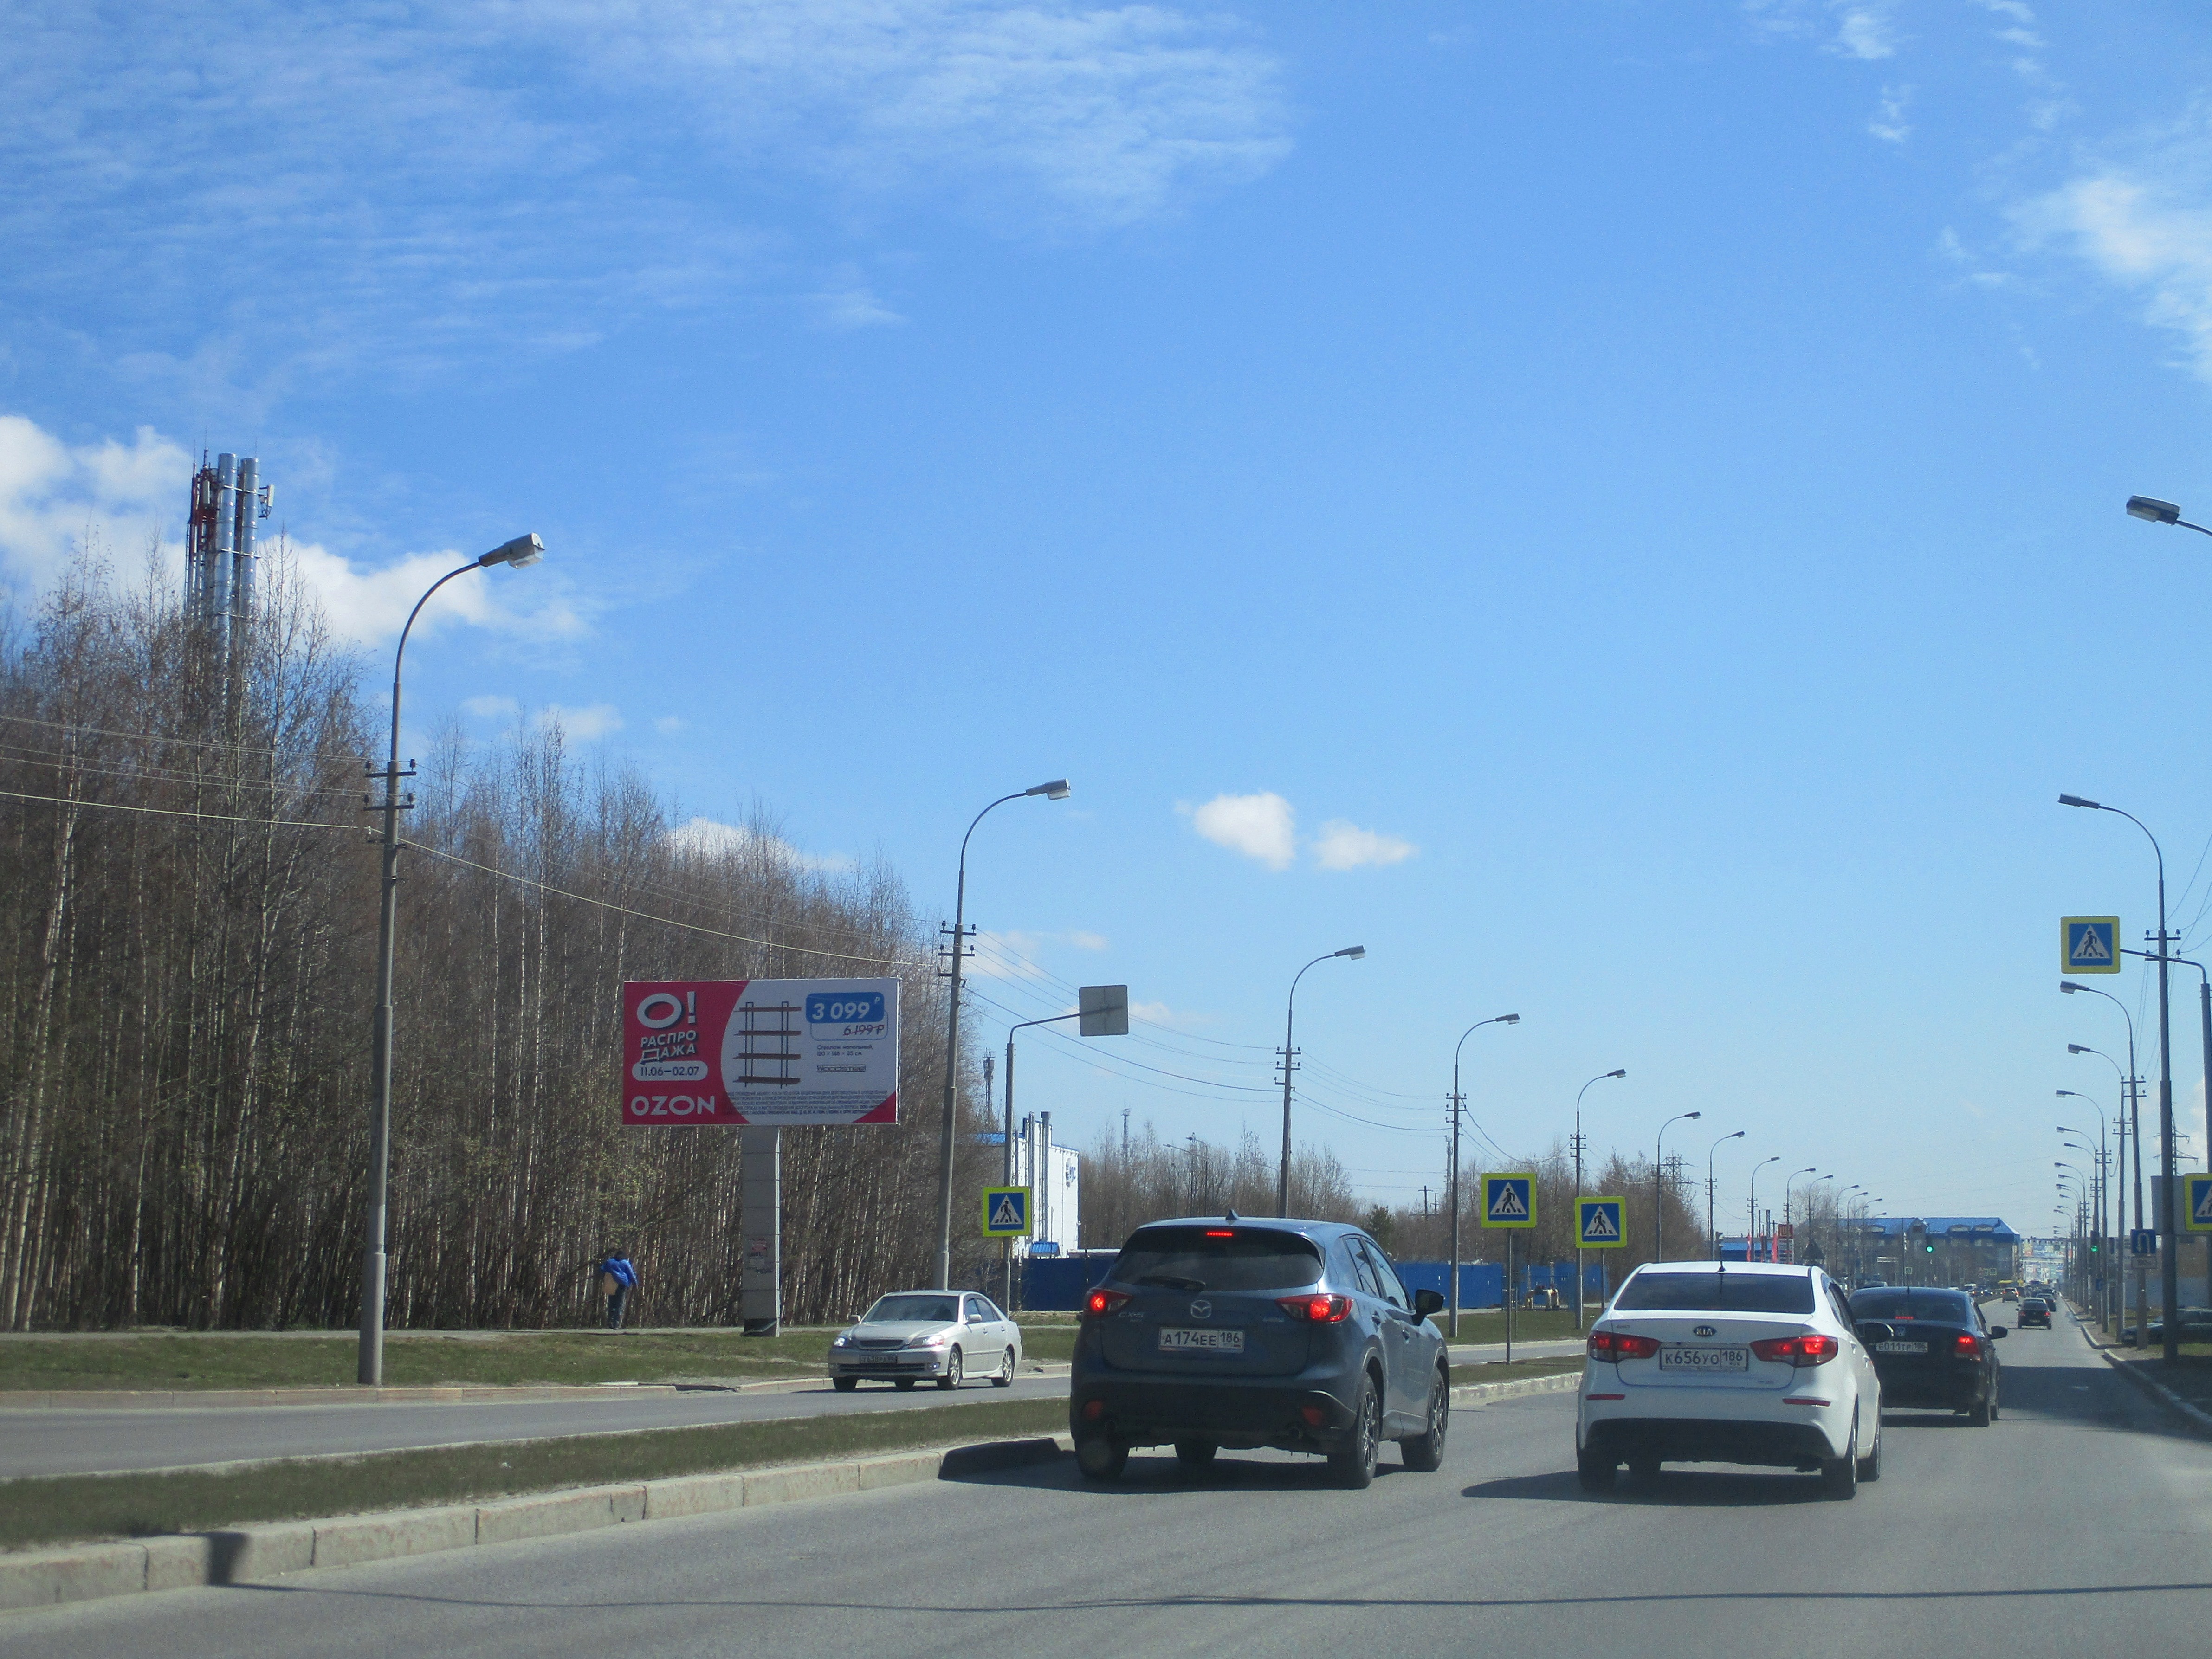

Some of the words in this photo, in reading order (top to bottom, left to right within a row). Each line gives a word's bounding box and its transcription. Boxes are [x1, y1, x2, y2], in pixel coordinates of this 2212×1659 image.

[640, 1030, 696, 1048] РАСПРО
[640, 1043, 696, 1063] ДАЖА
[631, 1096, 715, 1116] OZON
[1220, 1332, 1240, 1343] 186
[1722, 1350, 1743, 1362] 186
